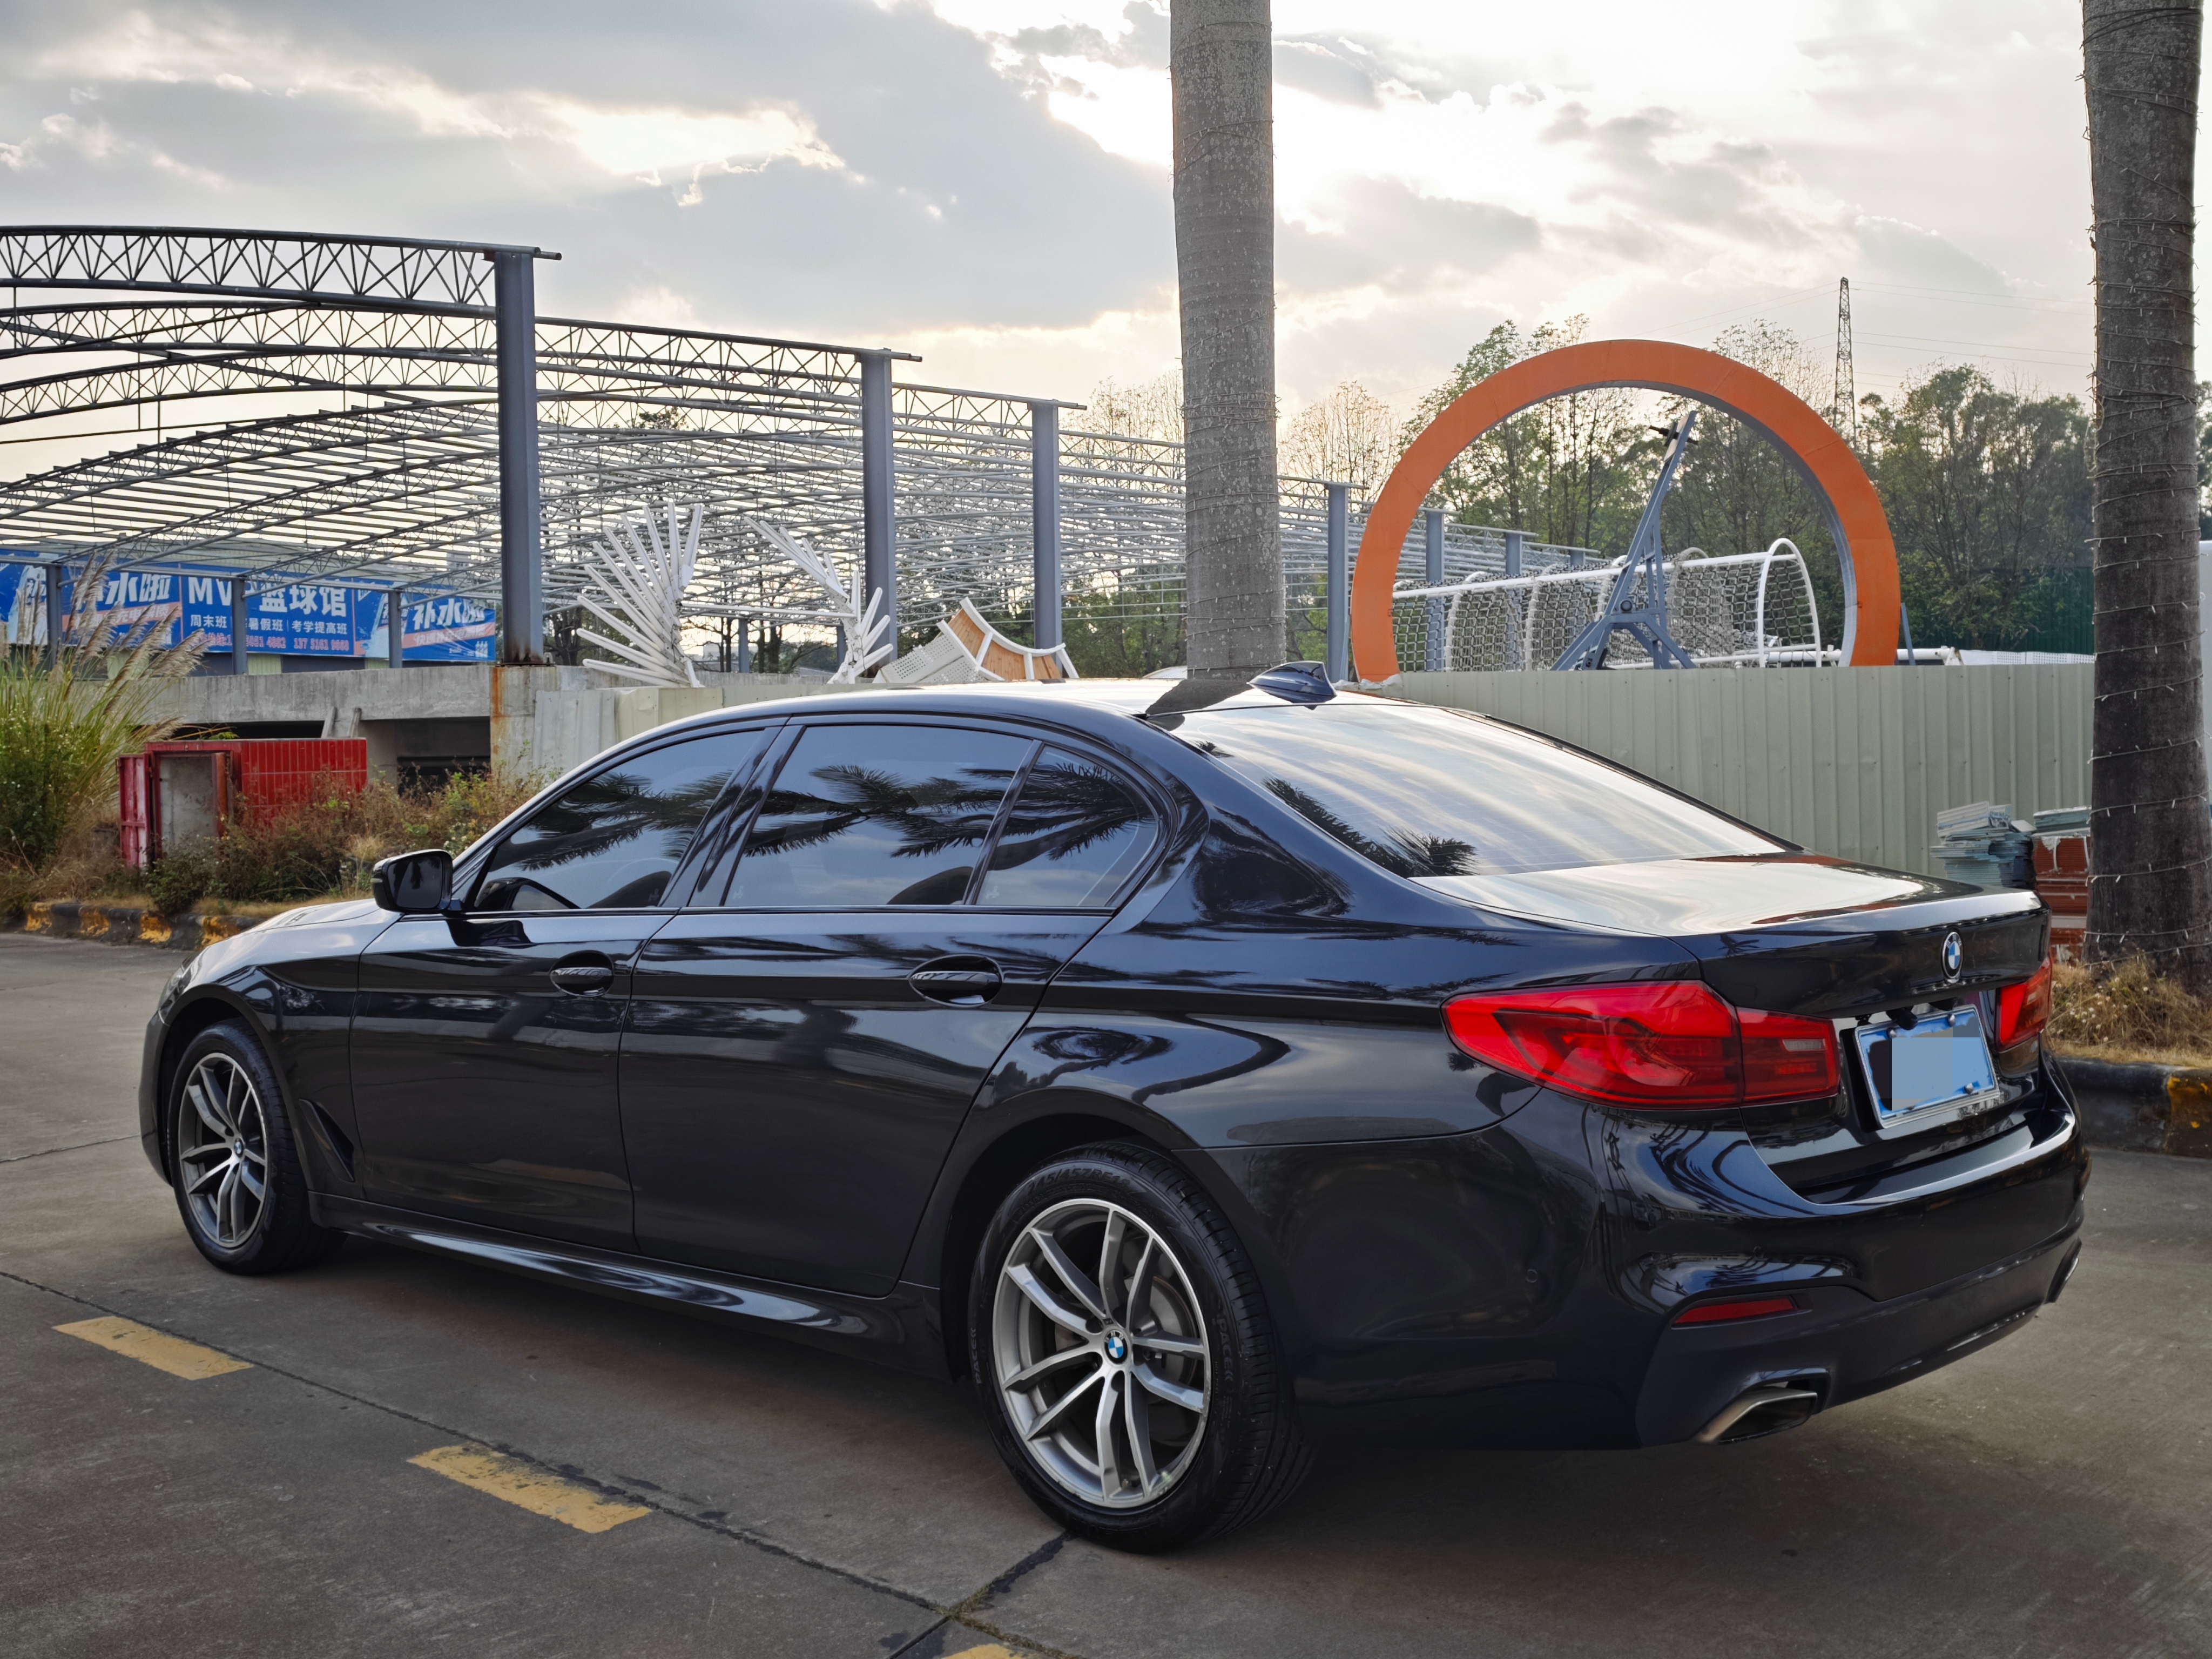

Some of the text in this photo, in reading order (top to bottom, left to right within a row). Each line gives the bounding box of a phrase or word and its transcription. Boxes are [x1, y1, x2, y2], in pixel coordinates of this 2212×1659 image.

[259, 574, 347, 617] 篮球馆
[190, 615, 347, 635] 周末班 暑假班 考学提高班
[1105, 1330, 1124, 1344] BMW
[971, 1338, 982, 1384] PACE
